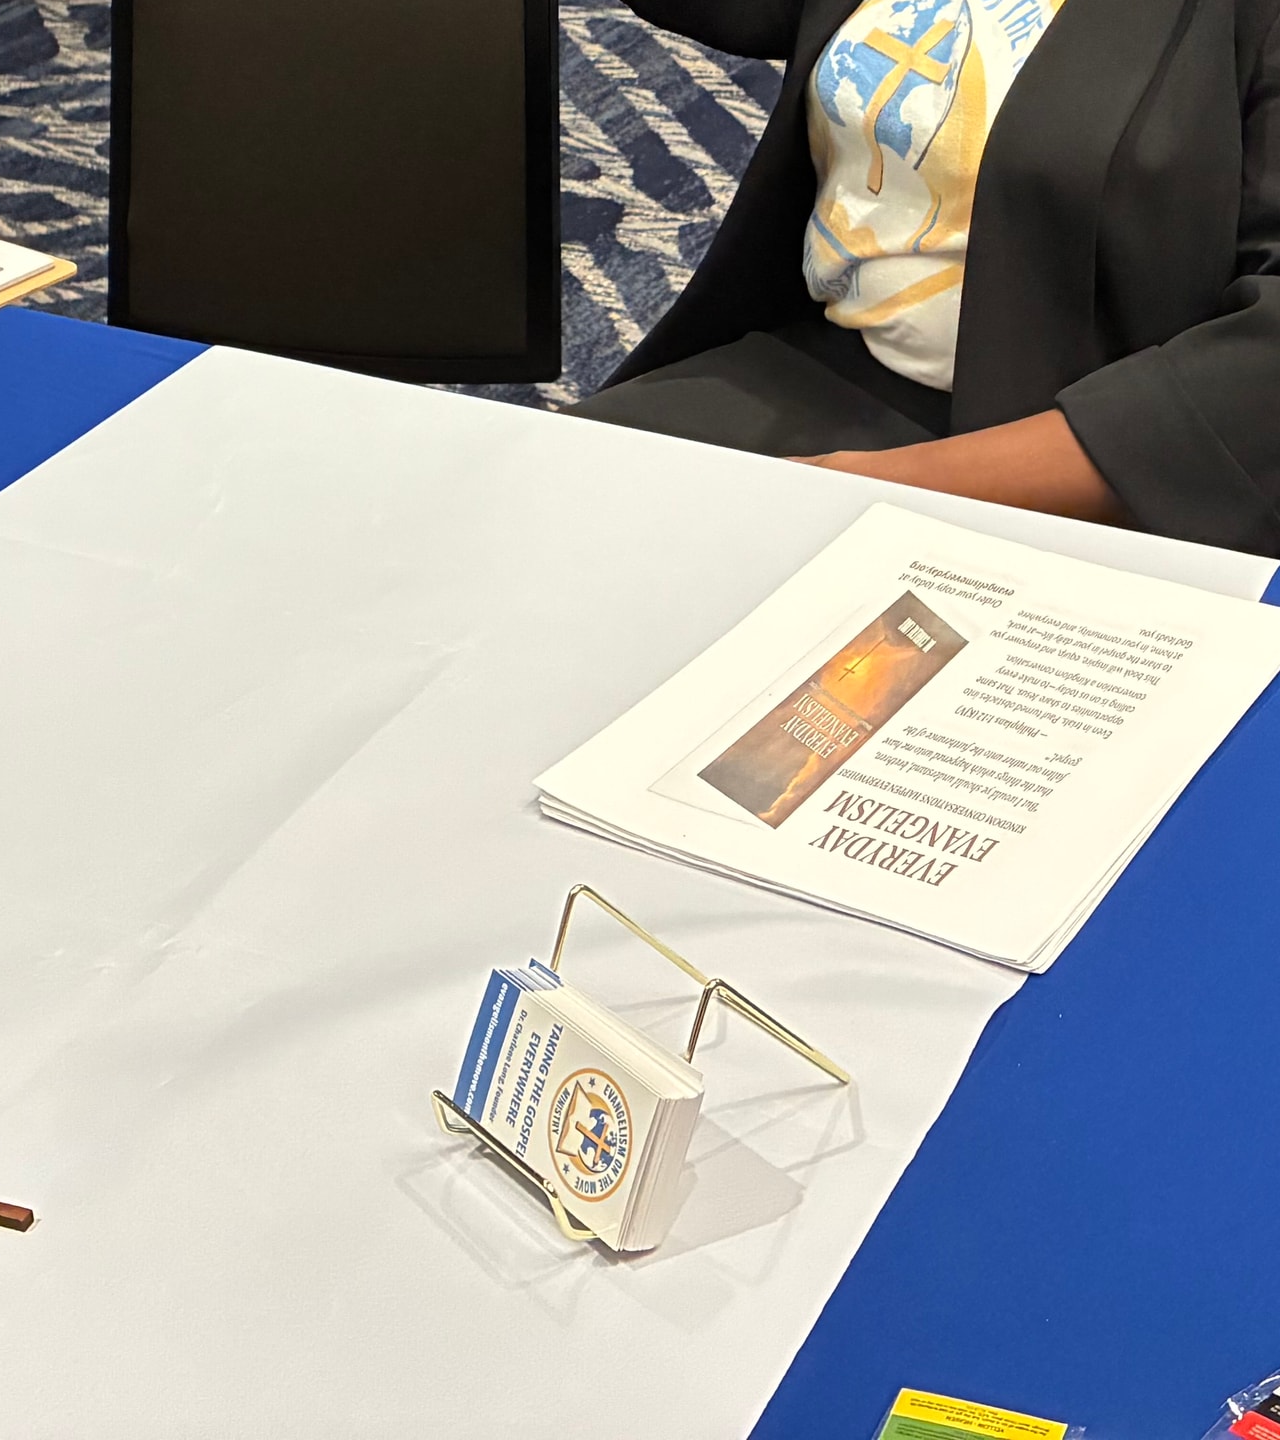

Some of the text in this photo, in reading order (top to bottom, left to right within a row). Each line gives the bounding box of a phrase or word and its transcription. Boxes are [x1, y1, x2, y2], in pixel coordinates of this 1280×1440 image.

[897, 572, 1003, 608] Order your copy today at
[908, 560, 1014, 596] evangelismeveryday.org
[779, 715, 838, 760] EVERYDAY
[793, 693, 859, 745] EVANGELISM
[953, 704, 1040, 737] Philippians 1:12 (KJV)
[880, 736, 1054, 797] that the things which happened unto me have
[901, 724, 1071, 783] fallen out rather unto the furtherance of the
[905, 761, 955, 783] understand,
[836, 768, 1027, 834] KINGDOM CONVERSATIONS HAPPEN EVERYWHERE
[949, 777, 983, 794] should
[979, 785, 996, 795] ye
[986, 789, 1018, 803] would
[1012, 797, 1024, 807] I
[825, 790, 998, 861] EVANGELISM
[809, 825, 956, 885] EVERYDAY
[463, 982, 508, 1114] evangelismonthemove.com
[488, 1008, 528, 1123] Dr. Charlene Long, Founder
[505, 1031, 541, 1127] EVERYWHERE
[514, 1023, 563, 1158] TAKING THE GOSPEL
[552, 1088, 571, 1135] MINISTRY
[574, 1084, 628, 1194] EVANGELISM ON THE MOVE
